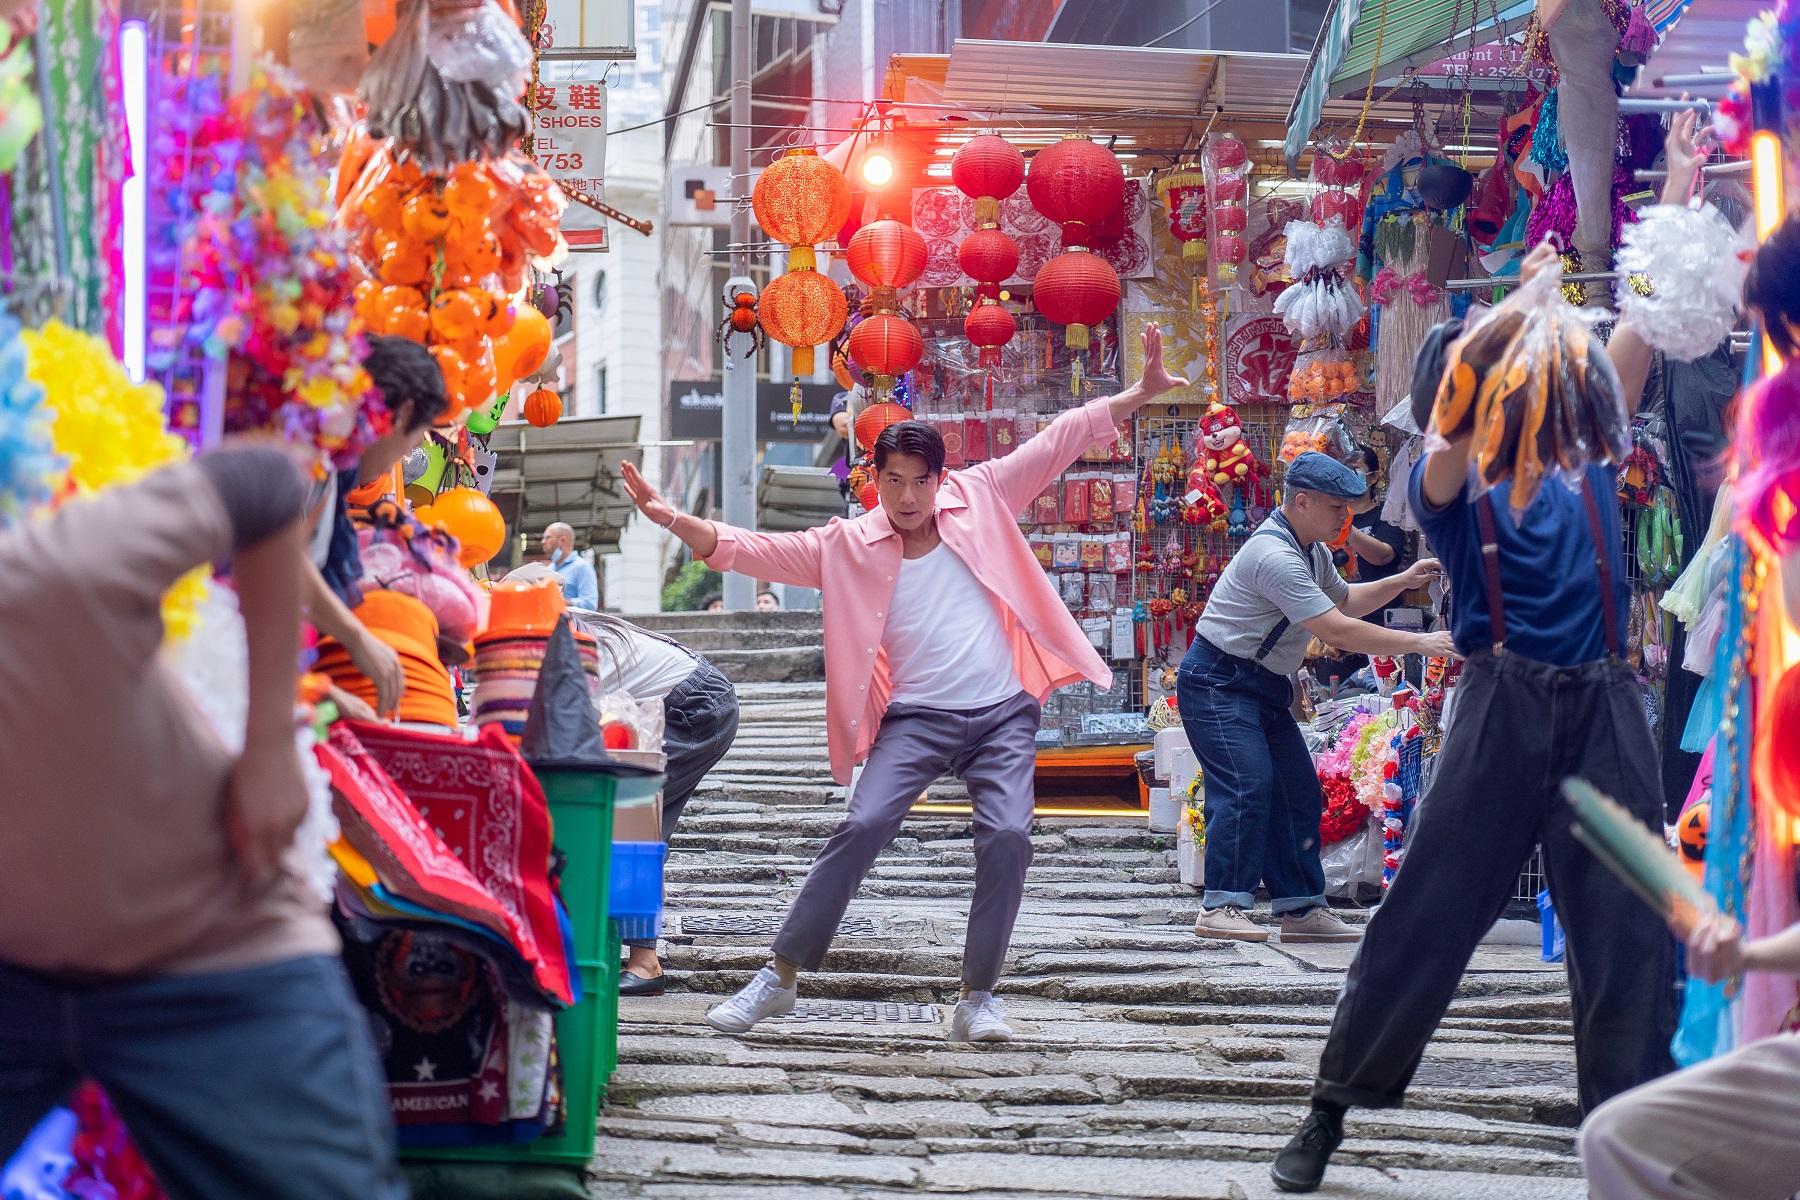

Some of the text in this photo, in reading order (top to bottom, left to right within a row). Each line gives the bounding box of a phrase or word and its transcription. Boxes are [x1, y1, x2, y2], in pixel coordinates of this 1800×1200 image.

[540, 115, 602, 129] SHOES
[534, 138, 559, 150] EL
[391, 1095, 469, 1112] AMERICAN
